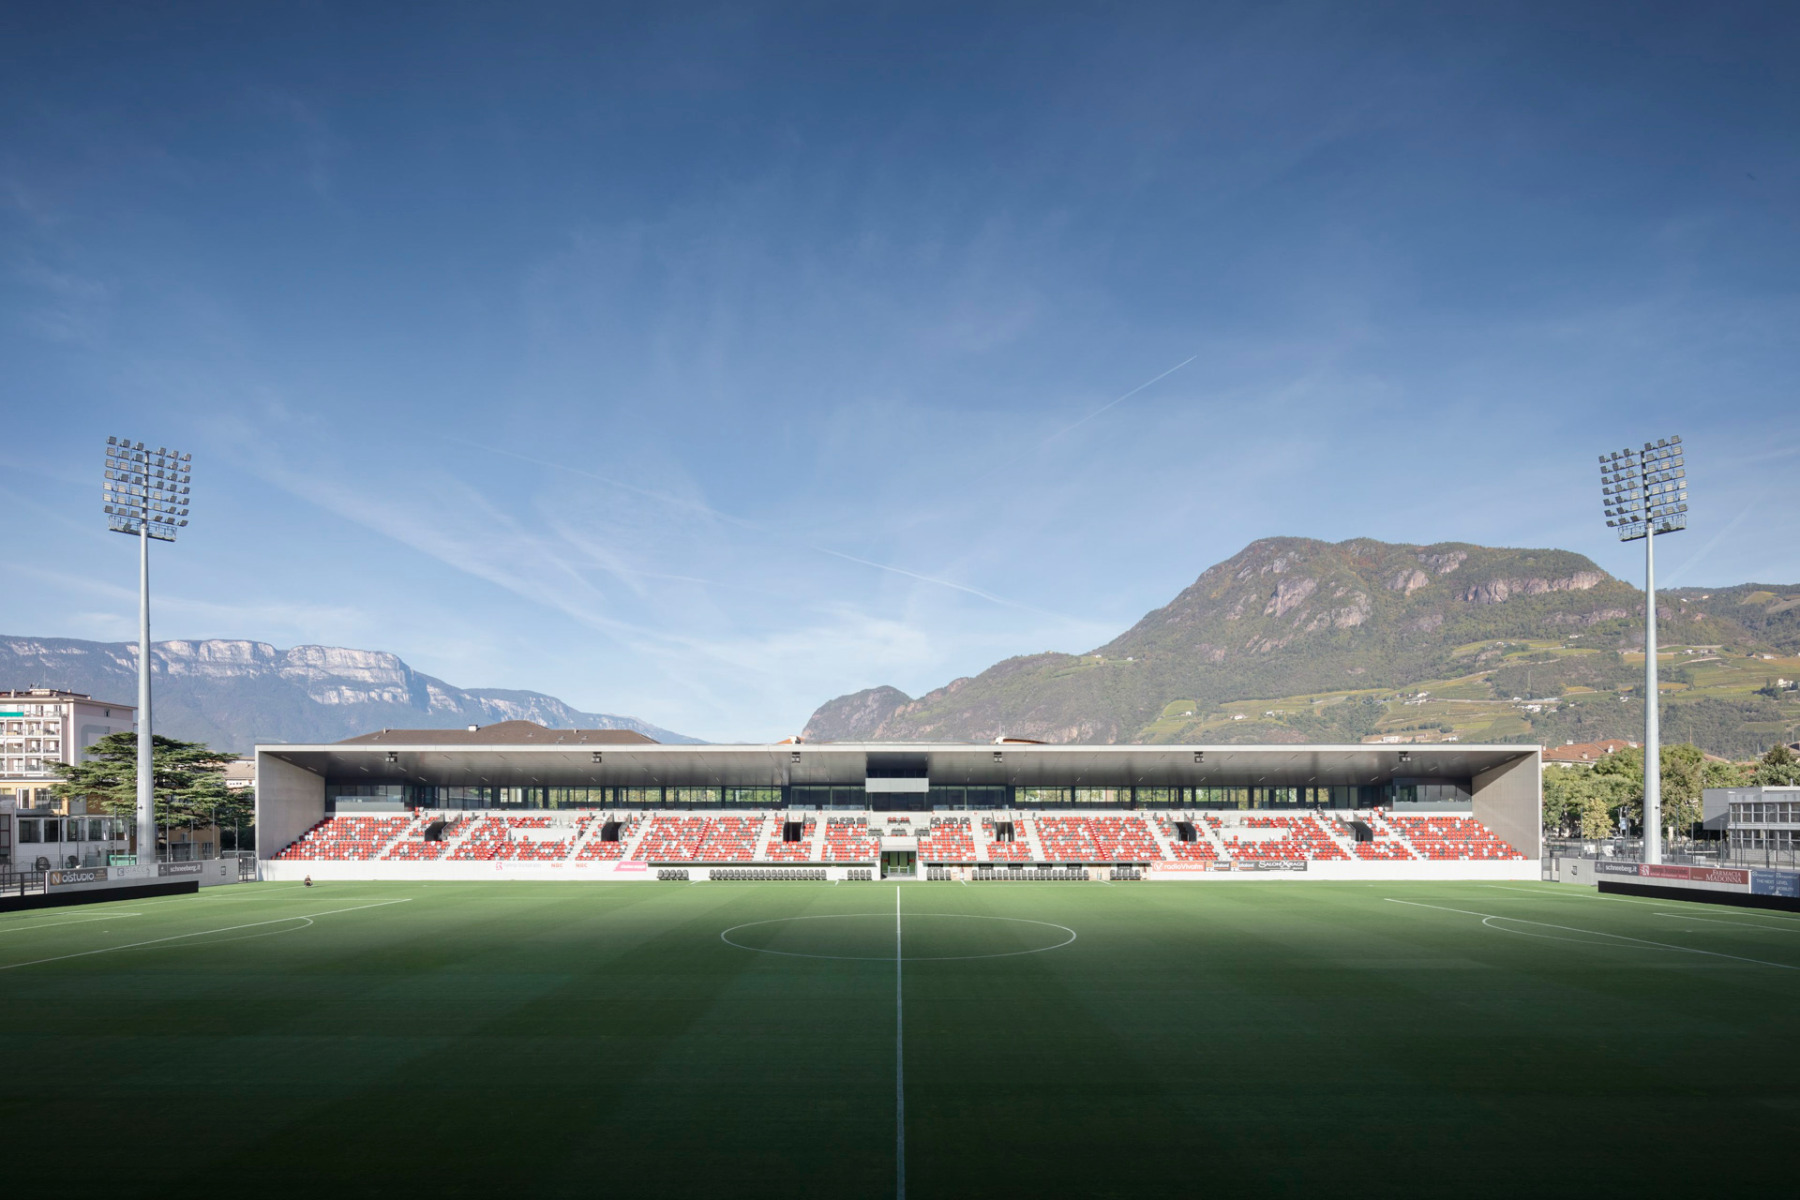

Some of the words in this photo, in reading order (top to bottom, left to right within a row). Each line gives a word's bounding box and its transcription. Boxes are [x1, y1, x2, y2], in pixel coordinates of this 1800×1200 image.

[170, 864, 201, 873] schneeberg.it
[1605, 864, 1637, 873] schneeberg.it
[1712, 869, 1742, 878] FARMACIA
[1705, 873, 1742, 884] MADONNA
